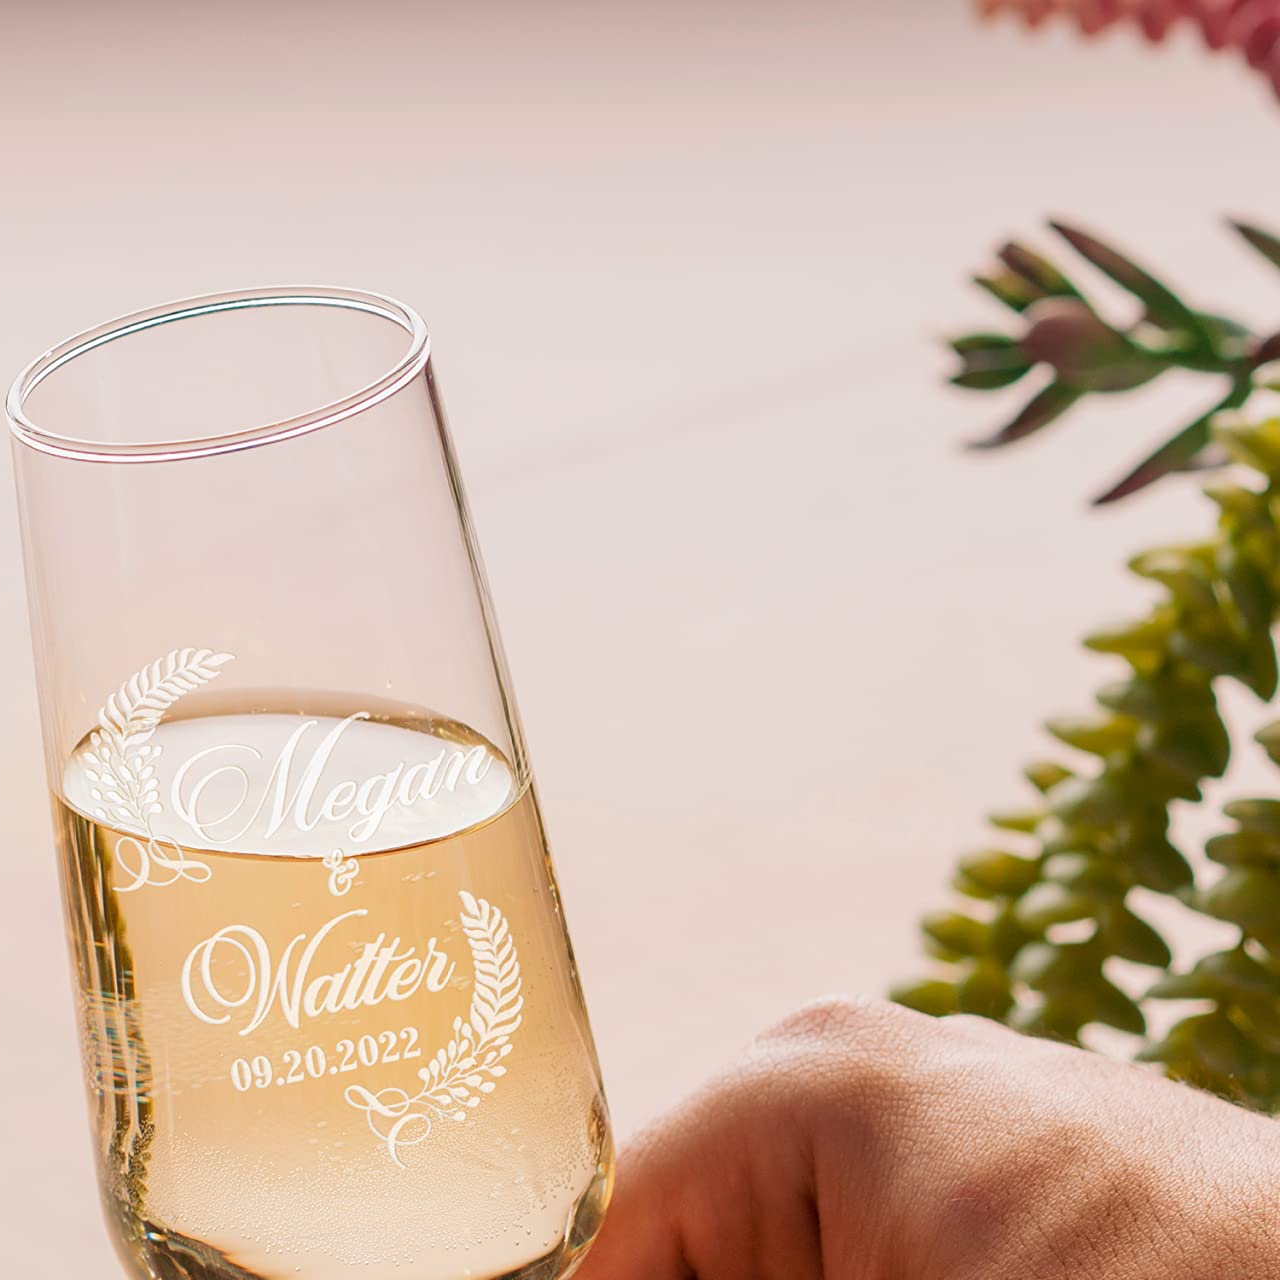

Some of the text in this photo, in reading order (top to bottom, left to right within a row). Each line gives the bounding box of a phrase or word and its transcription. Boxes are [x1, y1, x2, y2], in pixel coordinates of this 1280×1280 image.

[172, 712, 493, 843] Megan
[323, 848, 360, 896] &
[181, 909, 456, 1036] Watter
[231, 1027, 422, 1092] 09.20.2022
